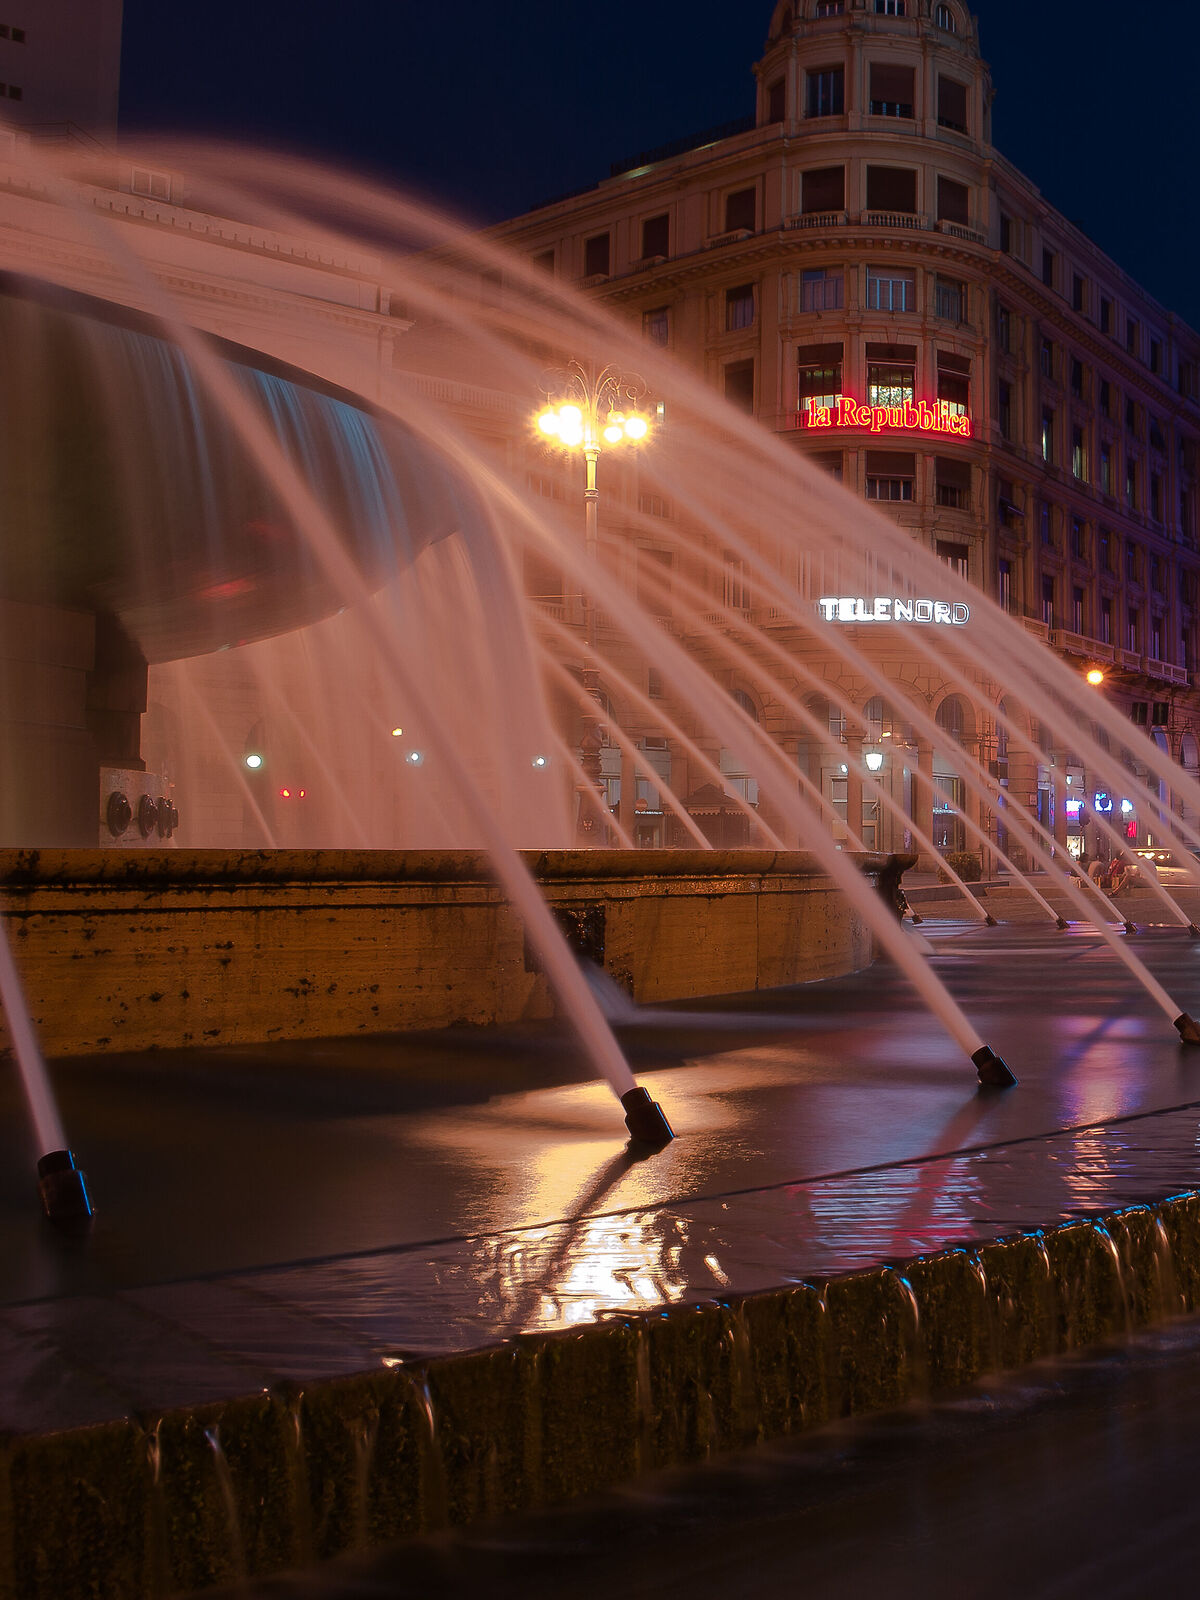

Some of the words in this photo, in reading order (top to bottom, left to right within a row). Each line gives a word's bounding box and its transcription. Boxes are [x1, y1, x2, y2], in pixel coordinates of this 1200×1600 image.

[807, 398, 832, 428] la
[836, 397, 971, 437] Repubblica
[819, 597, 970, 625] TELENORD
